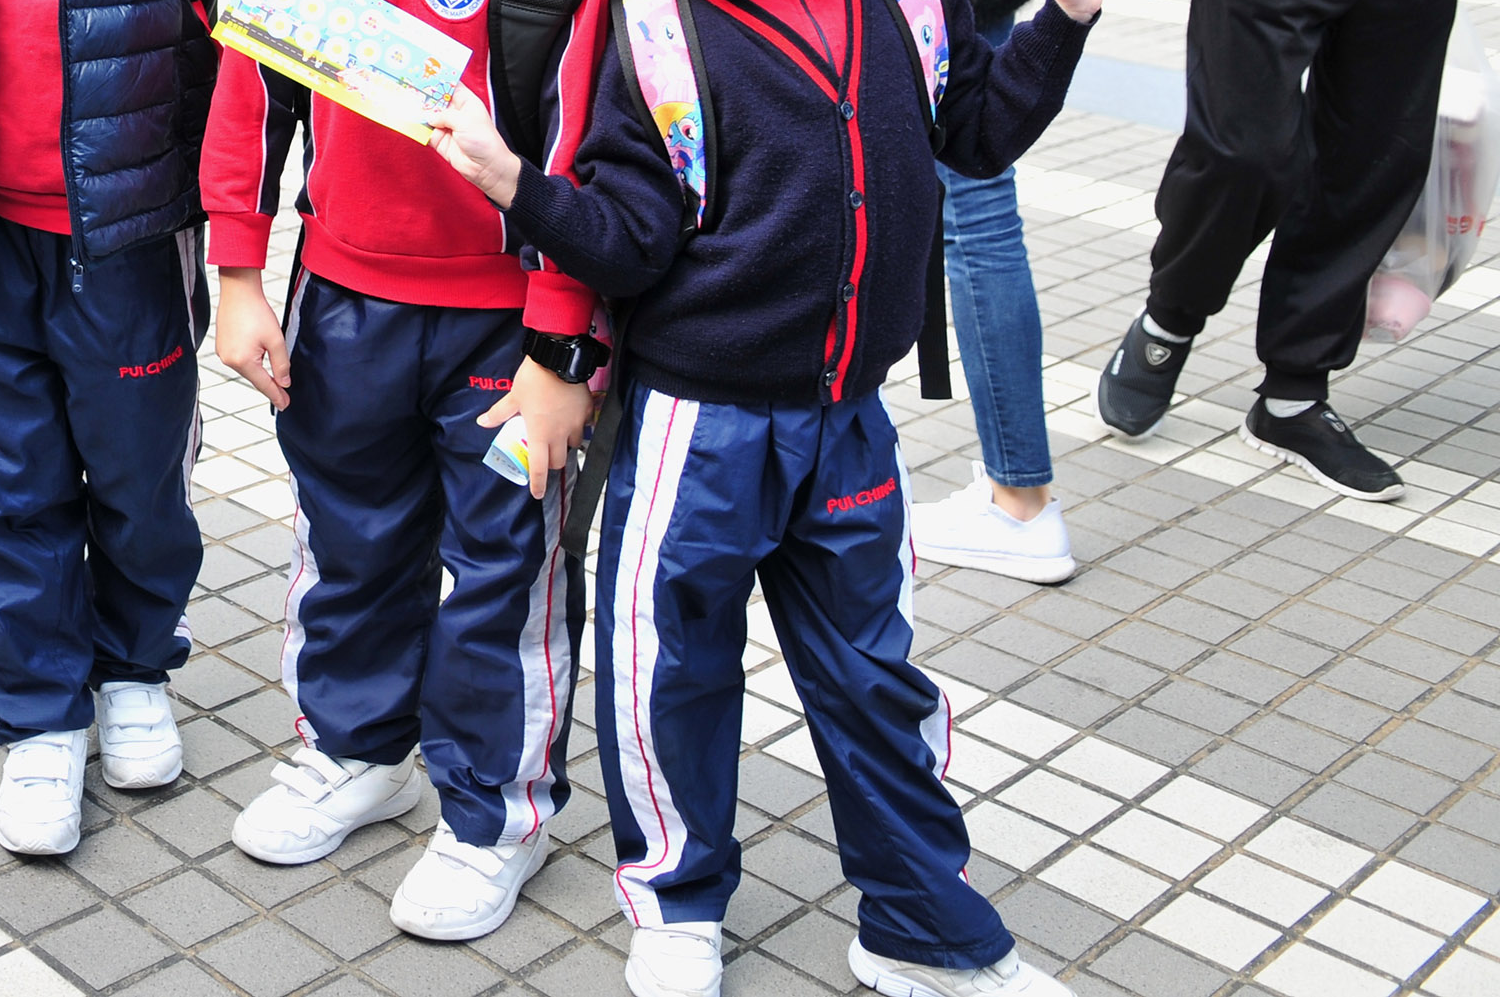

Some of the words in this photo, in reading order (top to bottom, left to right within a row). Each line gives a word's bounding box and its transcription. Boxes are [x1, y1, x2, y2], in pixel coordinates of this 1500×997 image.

[119, 366, 145, 379] PUI
[146, 345, 183, 375] CHING
[468, 375, 494, 390] PUI
[827, 495, 855, 514] PUI
[855, 477, 897, 506] CHING
